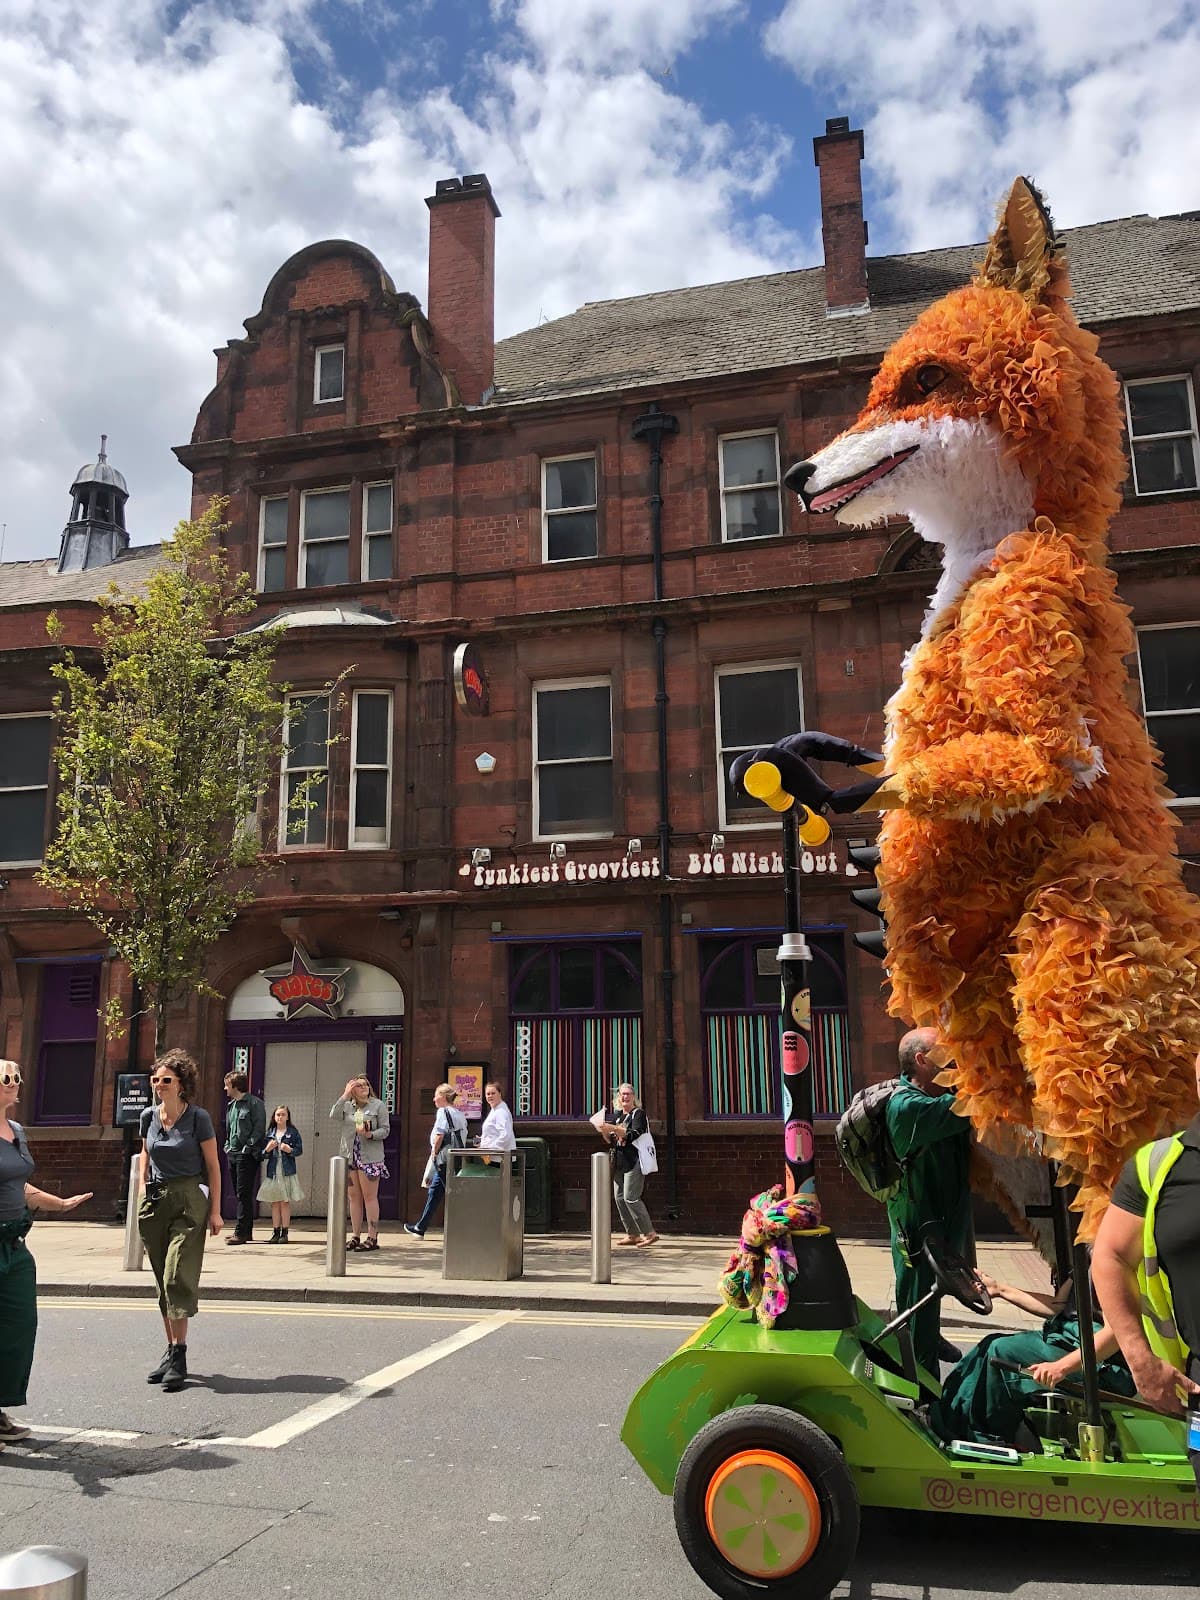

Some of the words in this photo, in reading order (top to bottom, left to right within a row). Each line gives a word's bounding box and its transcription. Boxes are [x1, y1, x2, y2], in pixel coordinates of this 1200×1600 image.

[564, 856, 660, 882] Grooviest
[687, 852, 726, 874] BIG
[731, 851, 785, 874] Nigh
[801, 851, 838, 874] Out
